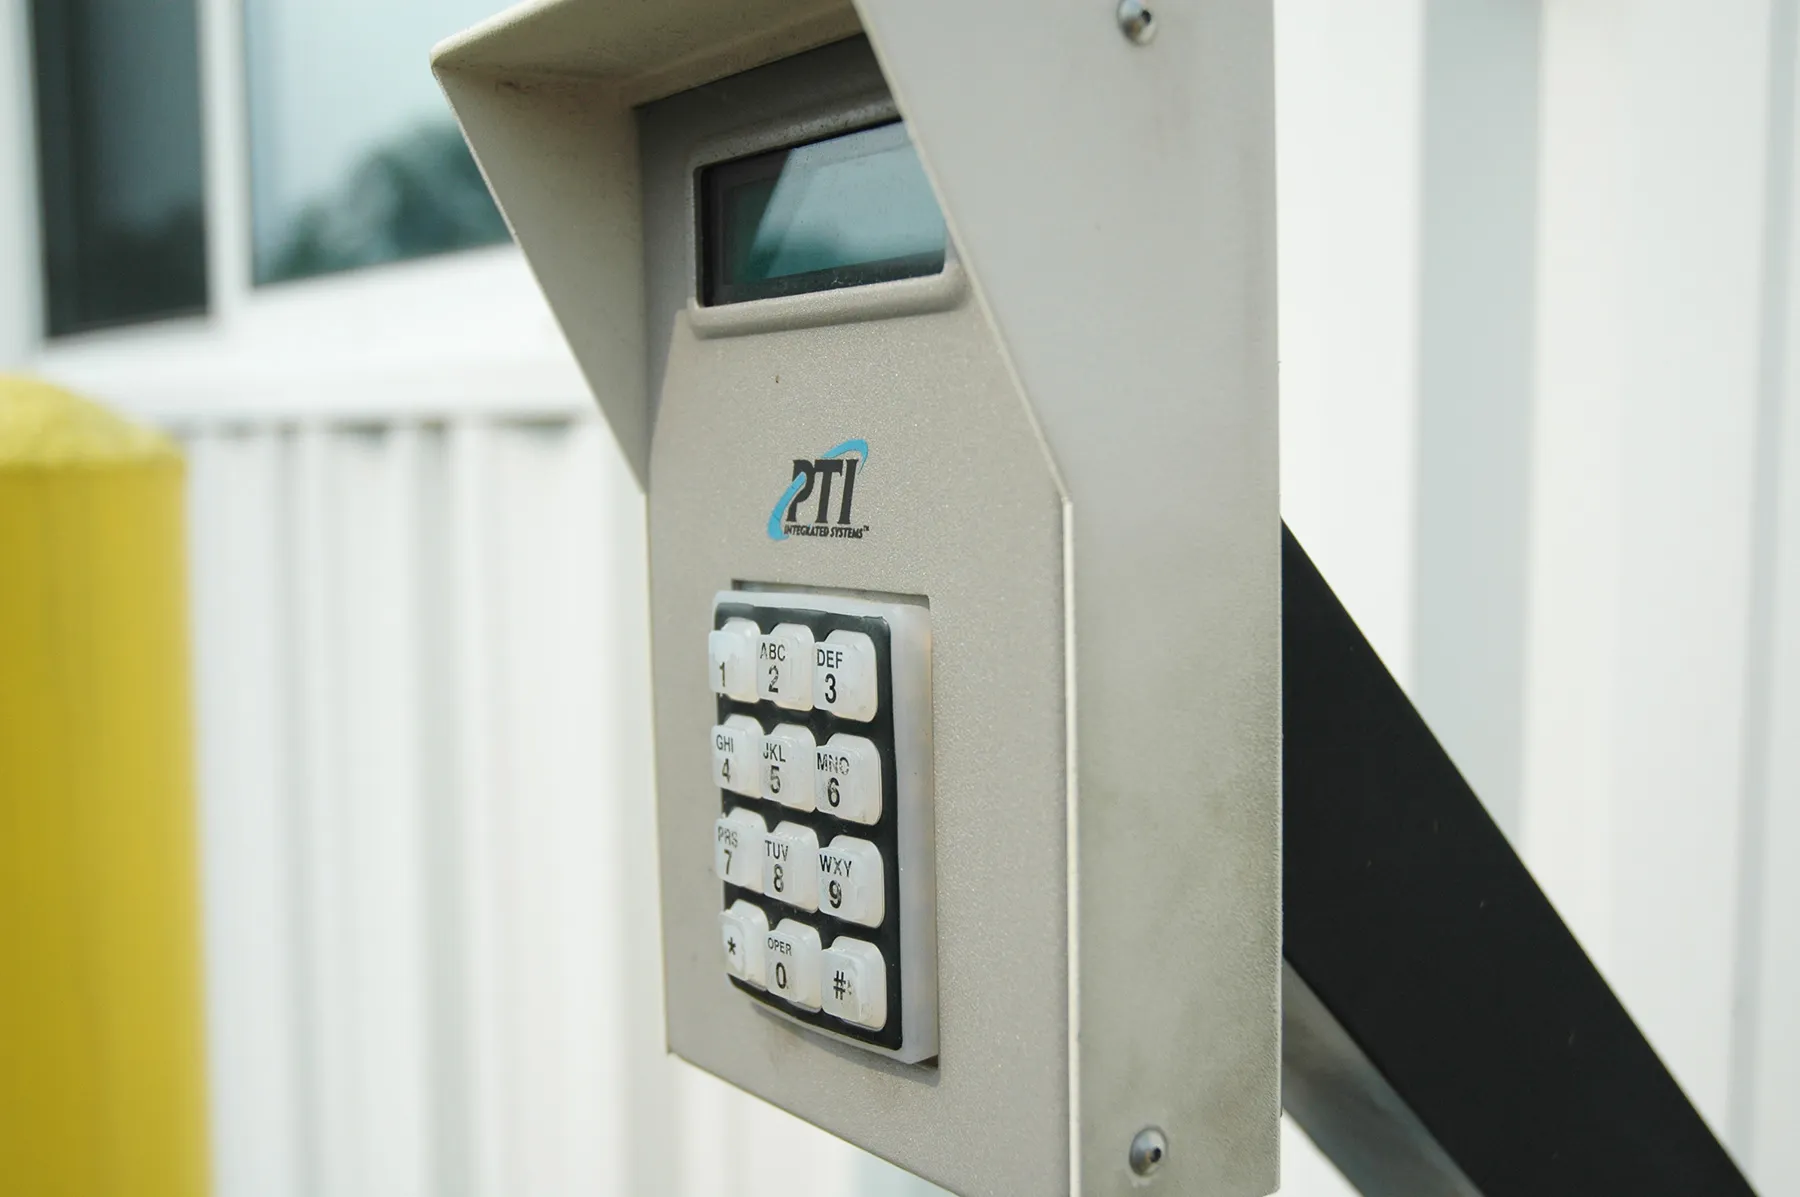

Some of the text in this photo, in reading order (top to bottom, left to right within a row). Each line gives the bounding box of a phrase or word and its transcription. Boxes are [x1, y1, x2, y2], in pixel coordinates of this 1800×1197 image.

[785, 459, 859, 524] PTI
[784, 525, 829, 537] INTEGRATED
[760, 642, 786, 662] ABC
[817, 649, 843, 669] DEF
[718, 662, 726, 687] 1
[768, 665, 779, 693] 2
[825, 673, 837, 703] 3
[716, 734, 734, 753] GHI
[763, 742, 786, 762] JKL
[721, 758, 731, 783] 4
[817, 752, 850, 776] MNO
[770, 766, 781, 793] 5
[827, 777, 840, 808] 6
[717, 826, 738, 848] PRS
[724, 849, 732, 875] 7
[765, 840, 789, 862] TUV
[773, 864, 784, 893] 8
[819, 854, 852, 878] WXY
[829, 880, 842, 909] 9
[767, 937, 792, 956] OPER
[775, 962, 787, 989] 0
[833, 970, 846, 1000] #
